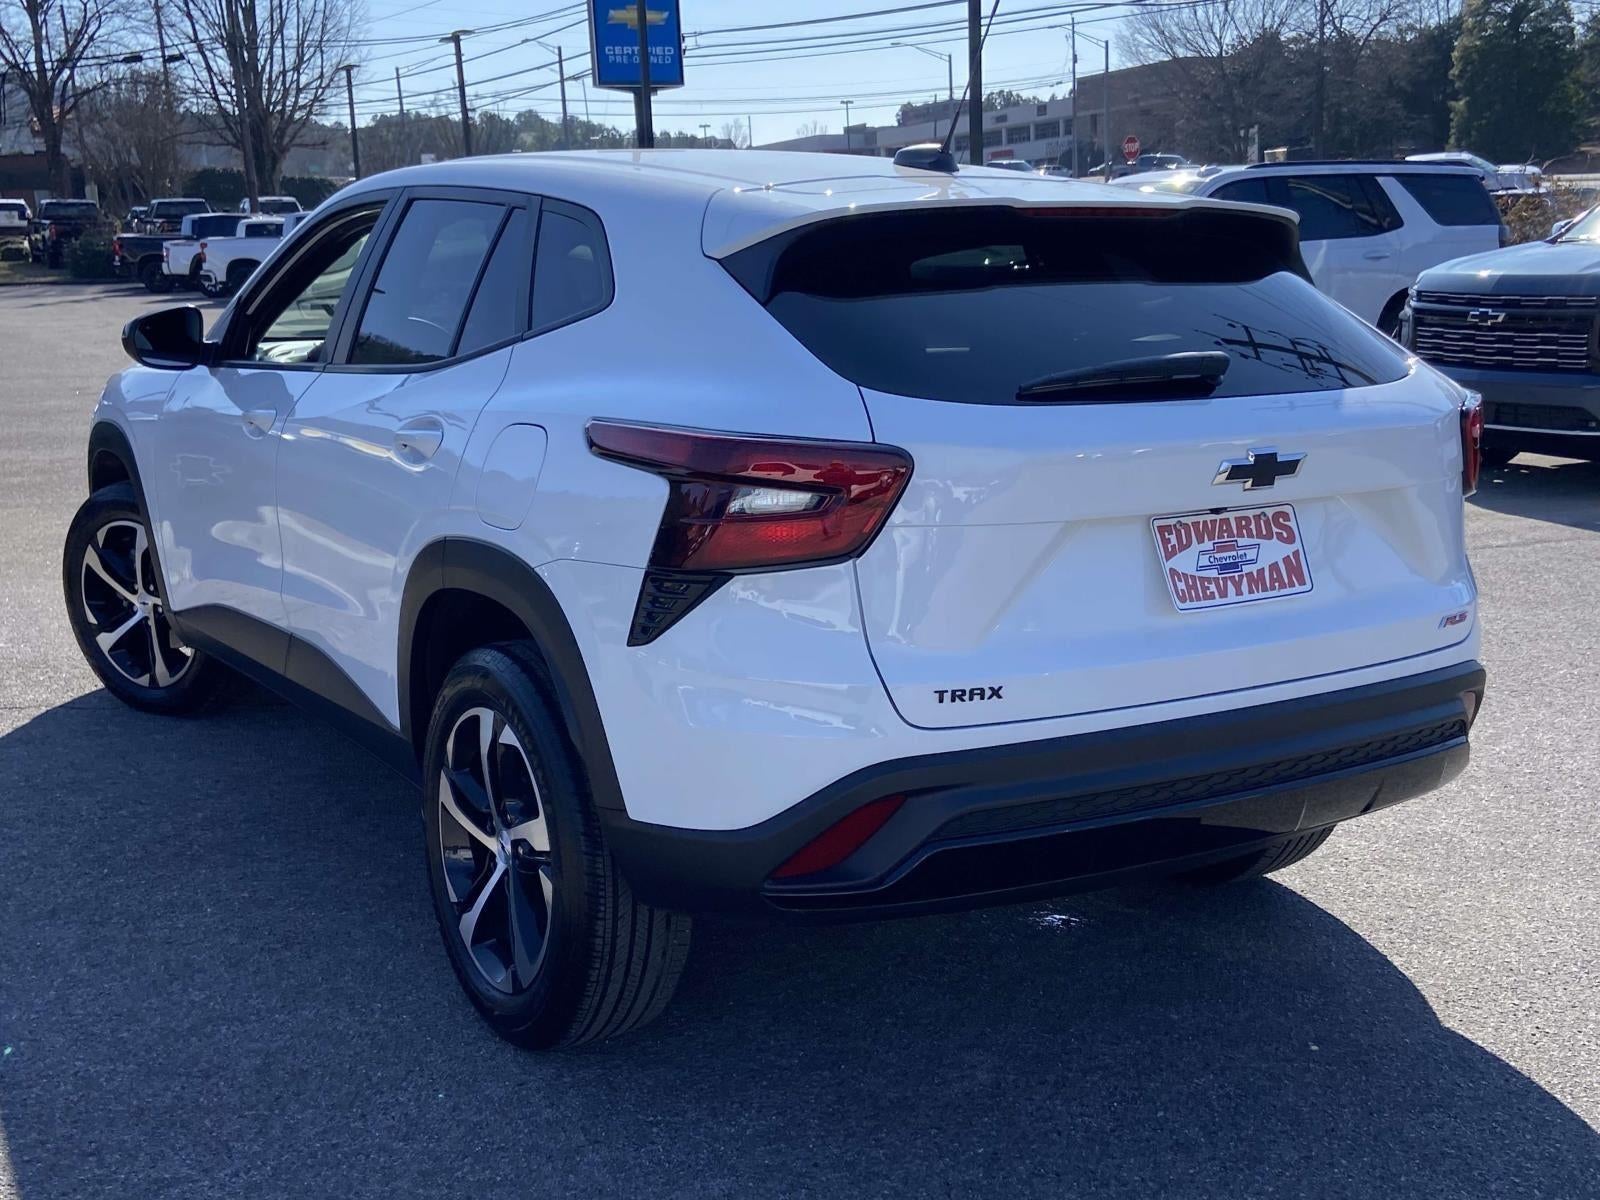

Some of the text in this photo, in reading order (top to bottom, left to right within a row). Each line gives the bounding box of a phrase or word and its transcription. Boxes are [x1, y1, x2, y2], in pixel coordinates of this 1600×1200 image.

[605, 46, 674, 55] CERTIED
[608, 55, 672, 64] PRE-ONED
[1124, 142, 1139, 153] STOP
[1157, 511, 1296, 562] EDWARDS
[1208, 551, 1248, 565] Chevrolet
[1168, 549, 1307, 604] CHEVYMAN
[933, 685, 1003, 704] TRAX
